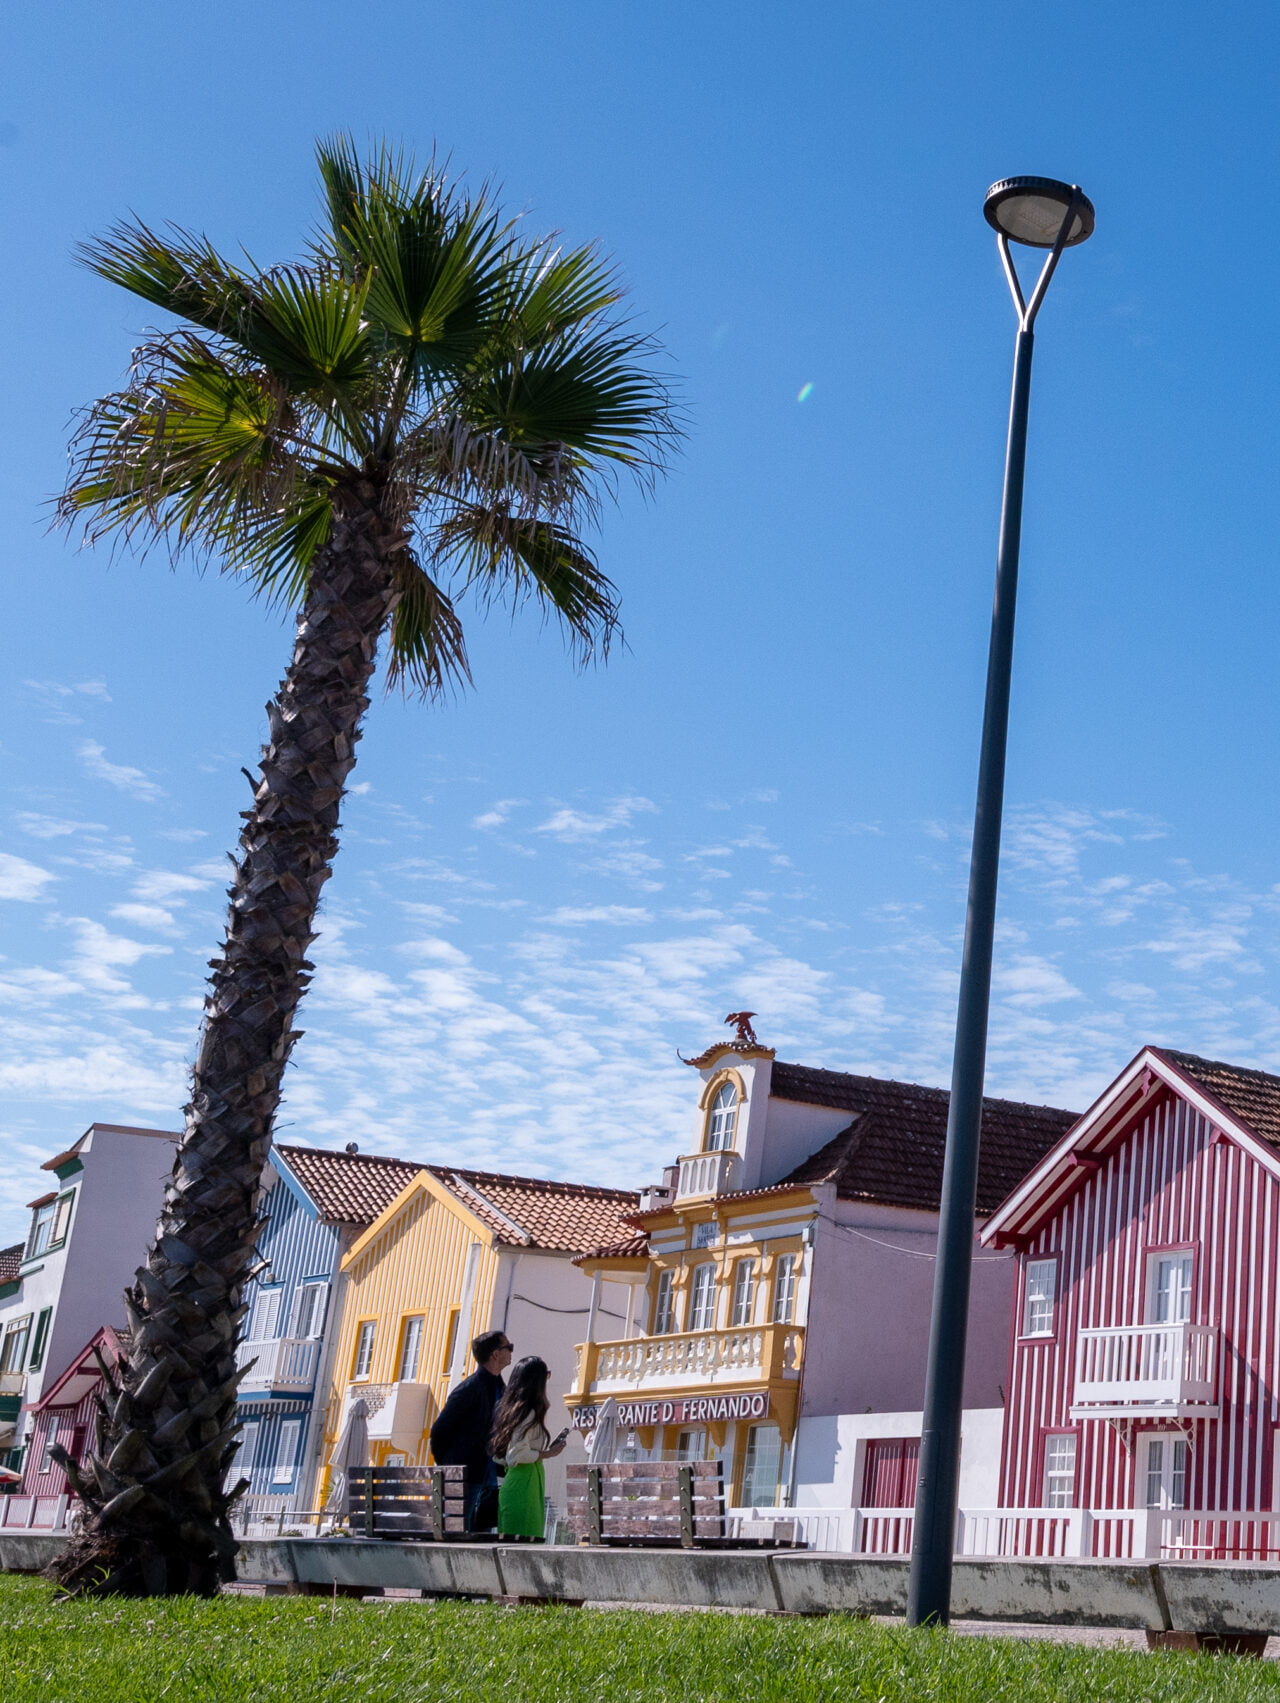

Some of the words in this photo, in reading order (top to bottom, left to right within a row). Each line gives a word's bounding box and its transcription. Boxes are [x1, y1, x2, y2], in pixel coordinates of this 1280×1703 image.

[573, 1403, 659, 1428] RESTRANTE
[662, 1400, 677, 1423] D.
[682, 1395, 765, 1421] FERNANDO
